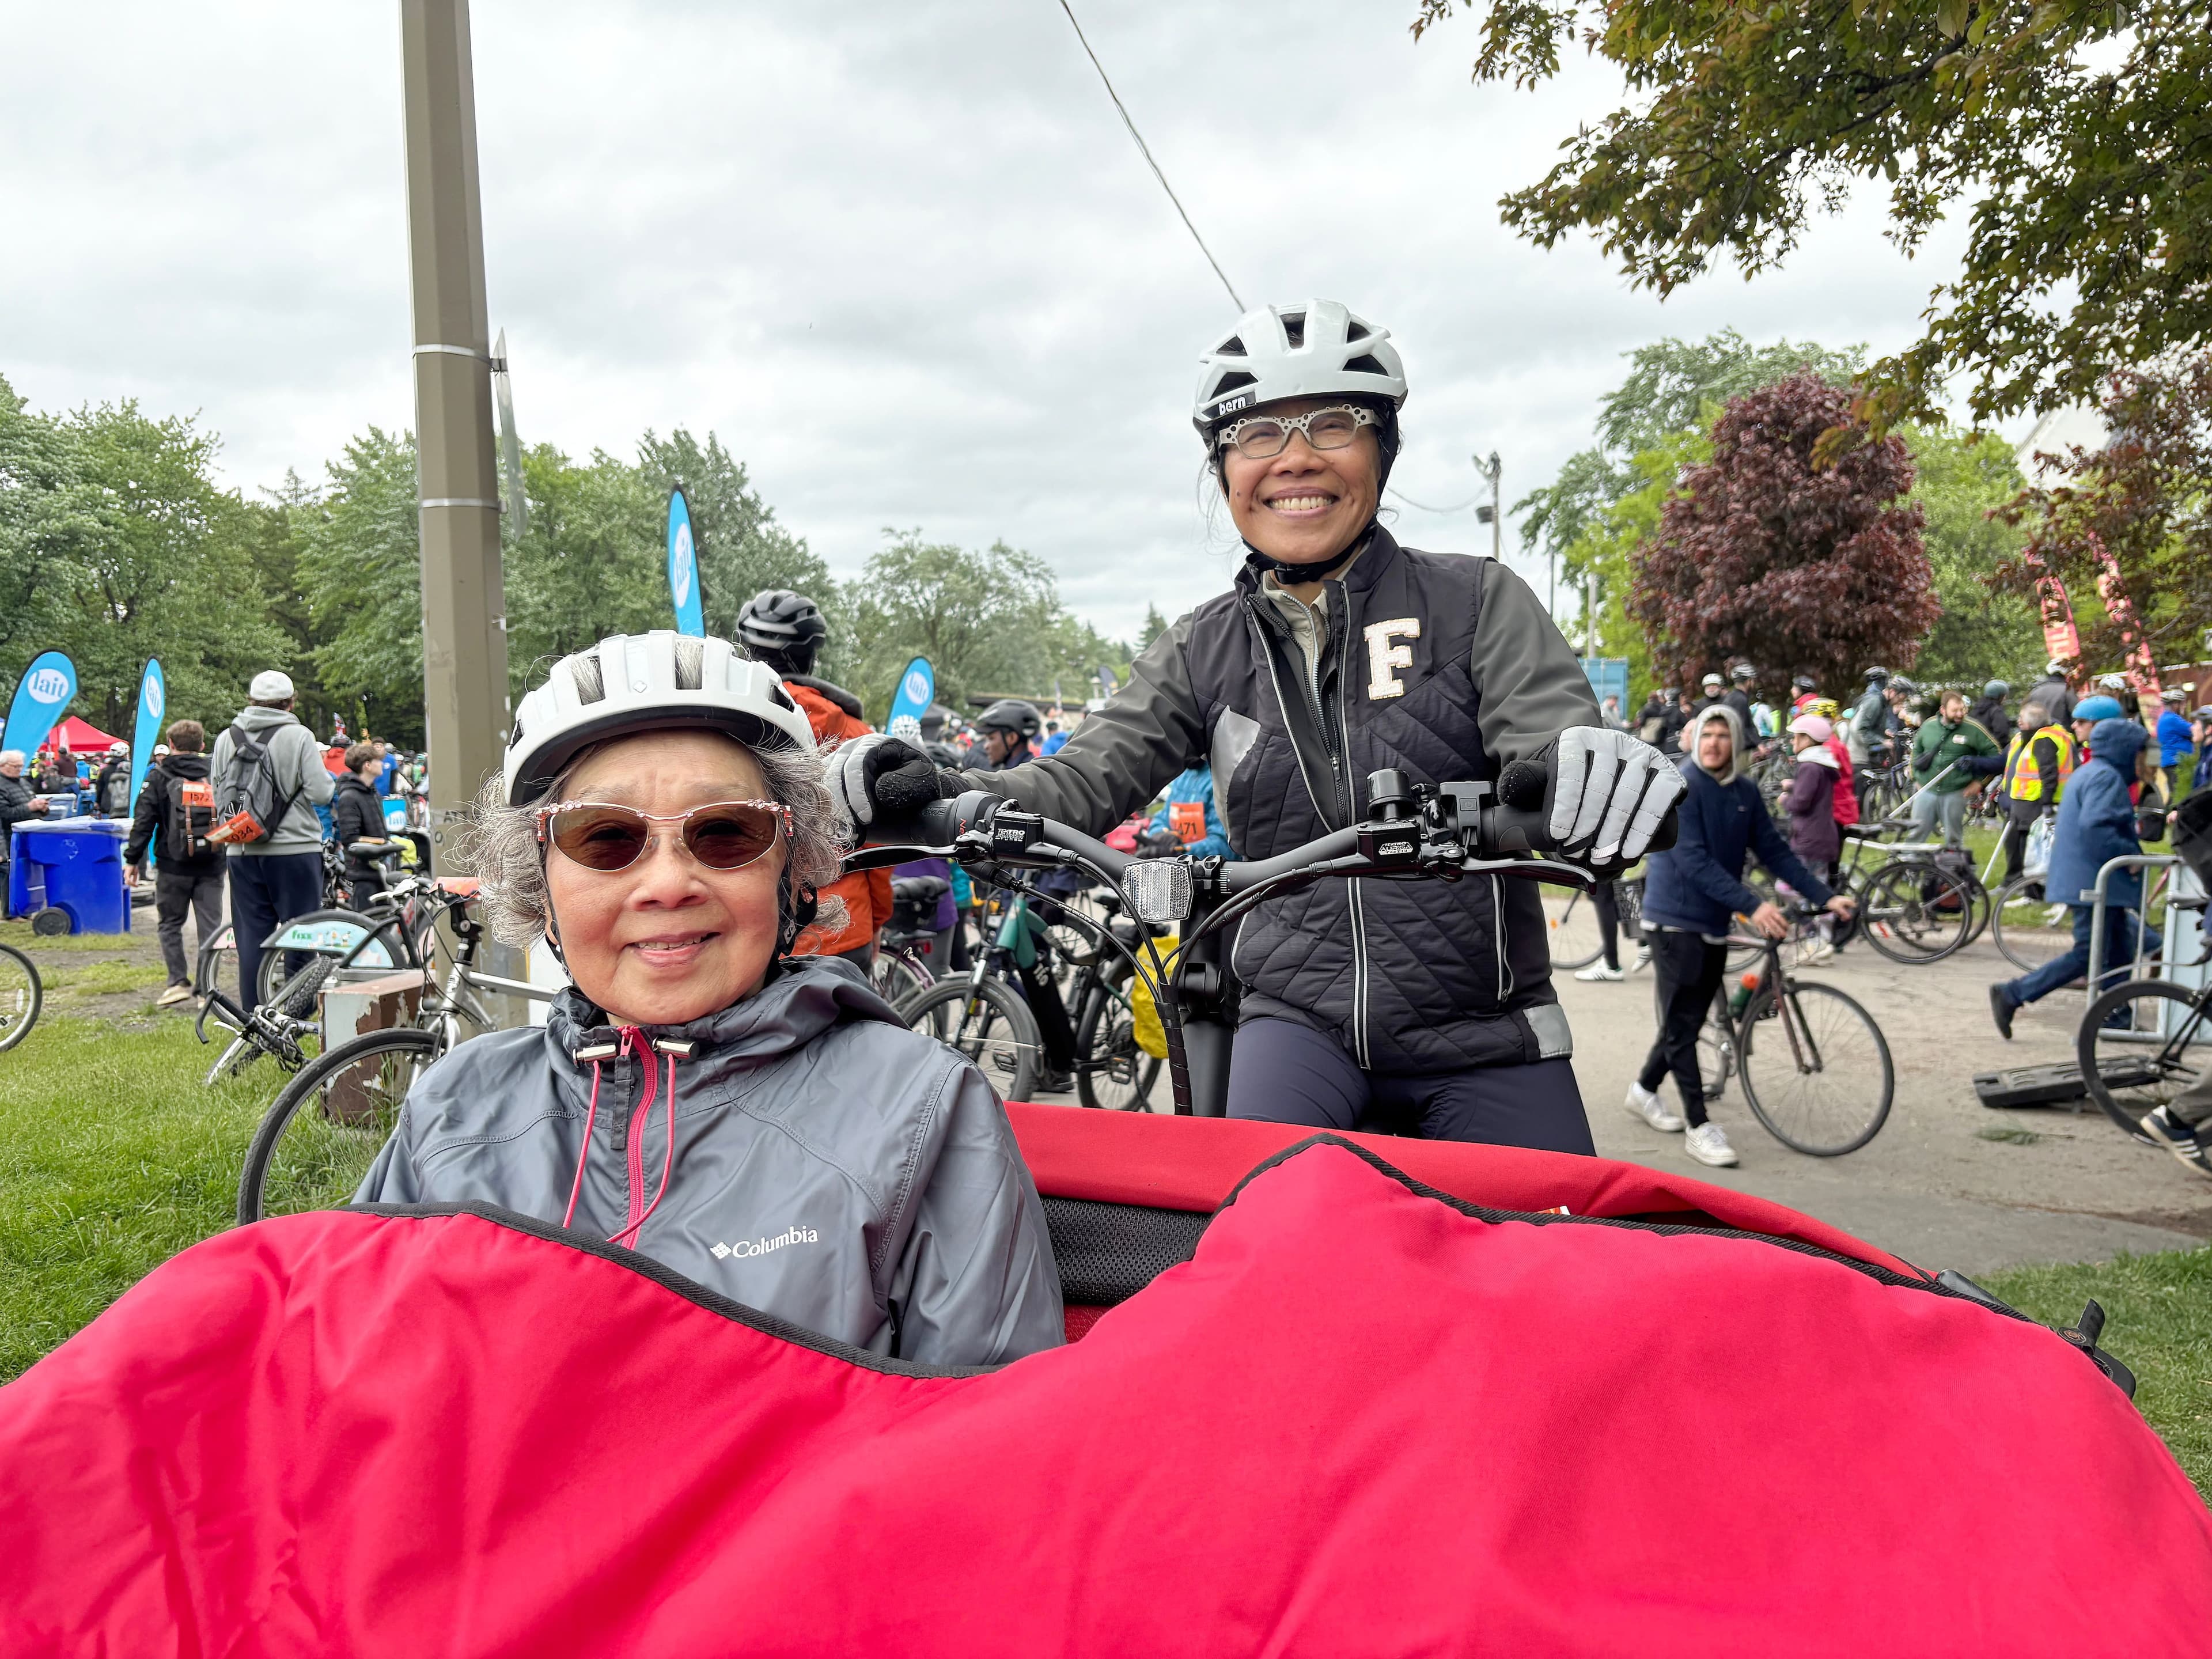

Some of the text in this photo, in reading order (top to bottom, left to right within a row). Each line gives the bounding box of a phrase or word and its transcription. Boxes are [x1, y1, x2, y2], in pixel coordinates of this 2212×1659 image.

[1218, 396, 1246, 415] bern
[1363, 618, 1421, 700] F
[33, 671, 67, 698] lait
[147, 676, 161, 711] lait
[732, 1225, 819, 1258] Columbia
